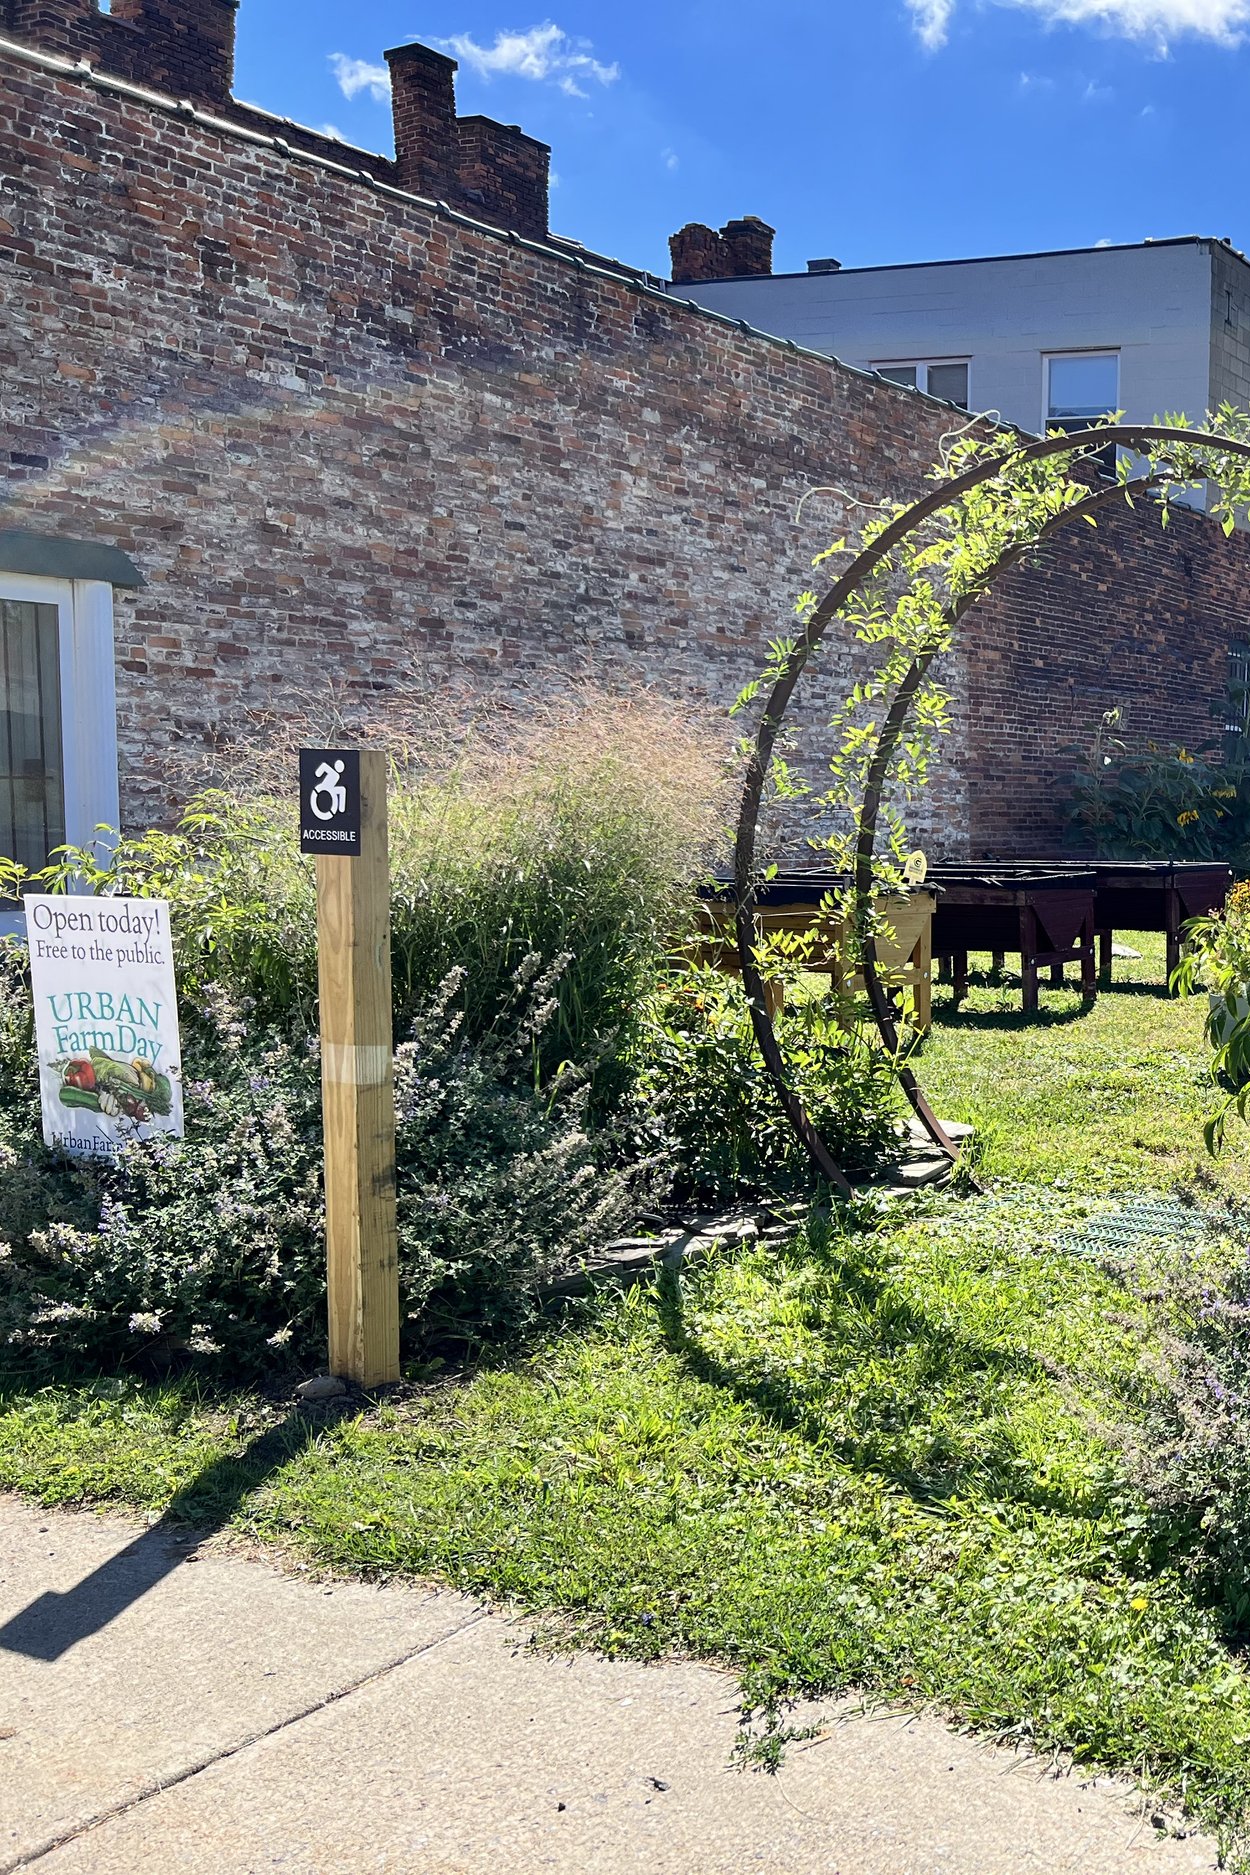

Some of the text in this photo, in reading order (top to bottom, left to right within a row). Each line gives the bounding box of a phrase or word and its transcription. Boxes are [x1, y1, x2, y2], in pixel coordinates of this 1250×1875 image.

[302, 829, 356, 842] ACCESSIBLE
[33, 903, 161, 943] Open today!
[36, 940, 165, 967] Free to the public.
[47, 991, 162, 1030] URBAN
[52, 1025, 163, 1065] FarmDay
